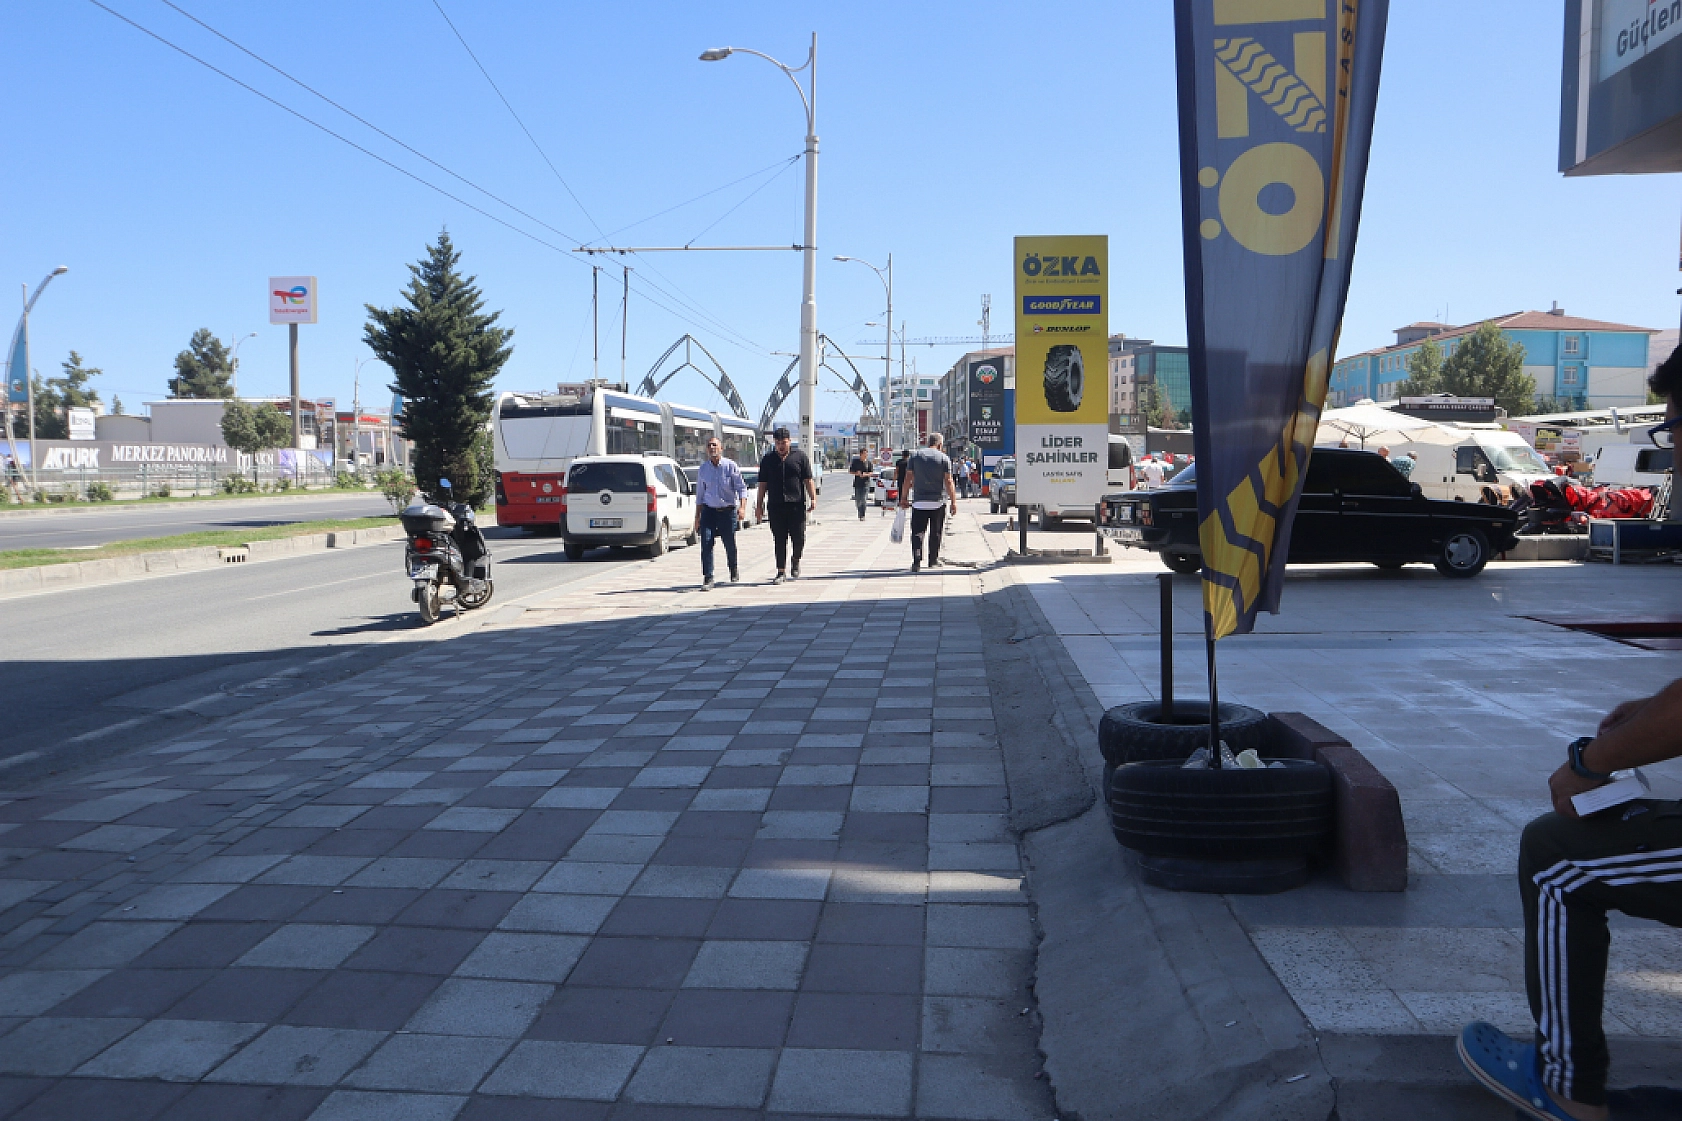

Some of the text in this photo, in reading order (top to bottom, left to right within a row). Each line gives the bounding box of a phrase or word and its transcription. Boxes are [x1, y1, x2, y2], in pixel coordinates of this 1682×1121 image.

[1023, 252, 1101, 277] ÖZKA
[1030, 298, 1094, 311] GOODYEAR
[1041, 434, 1084, 448] LİDER
[111, 444, 166, 462] MERKEZ
[166, 446, 228, 463] PANORAMA
[1026, 449, 1098, 466] ŞAHİNLER
